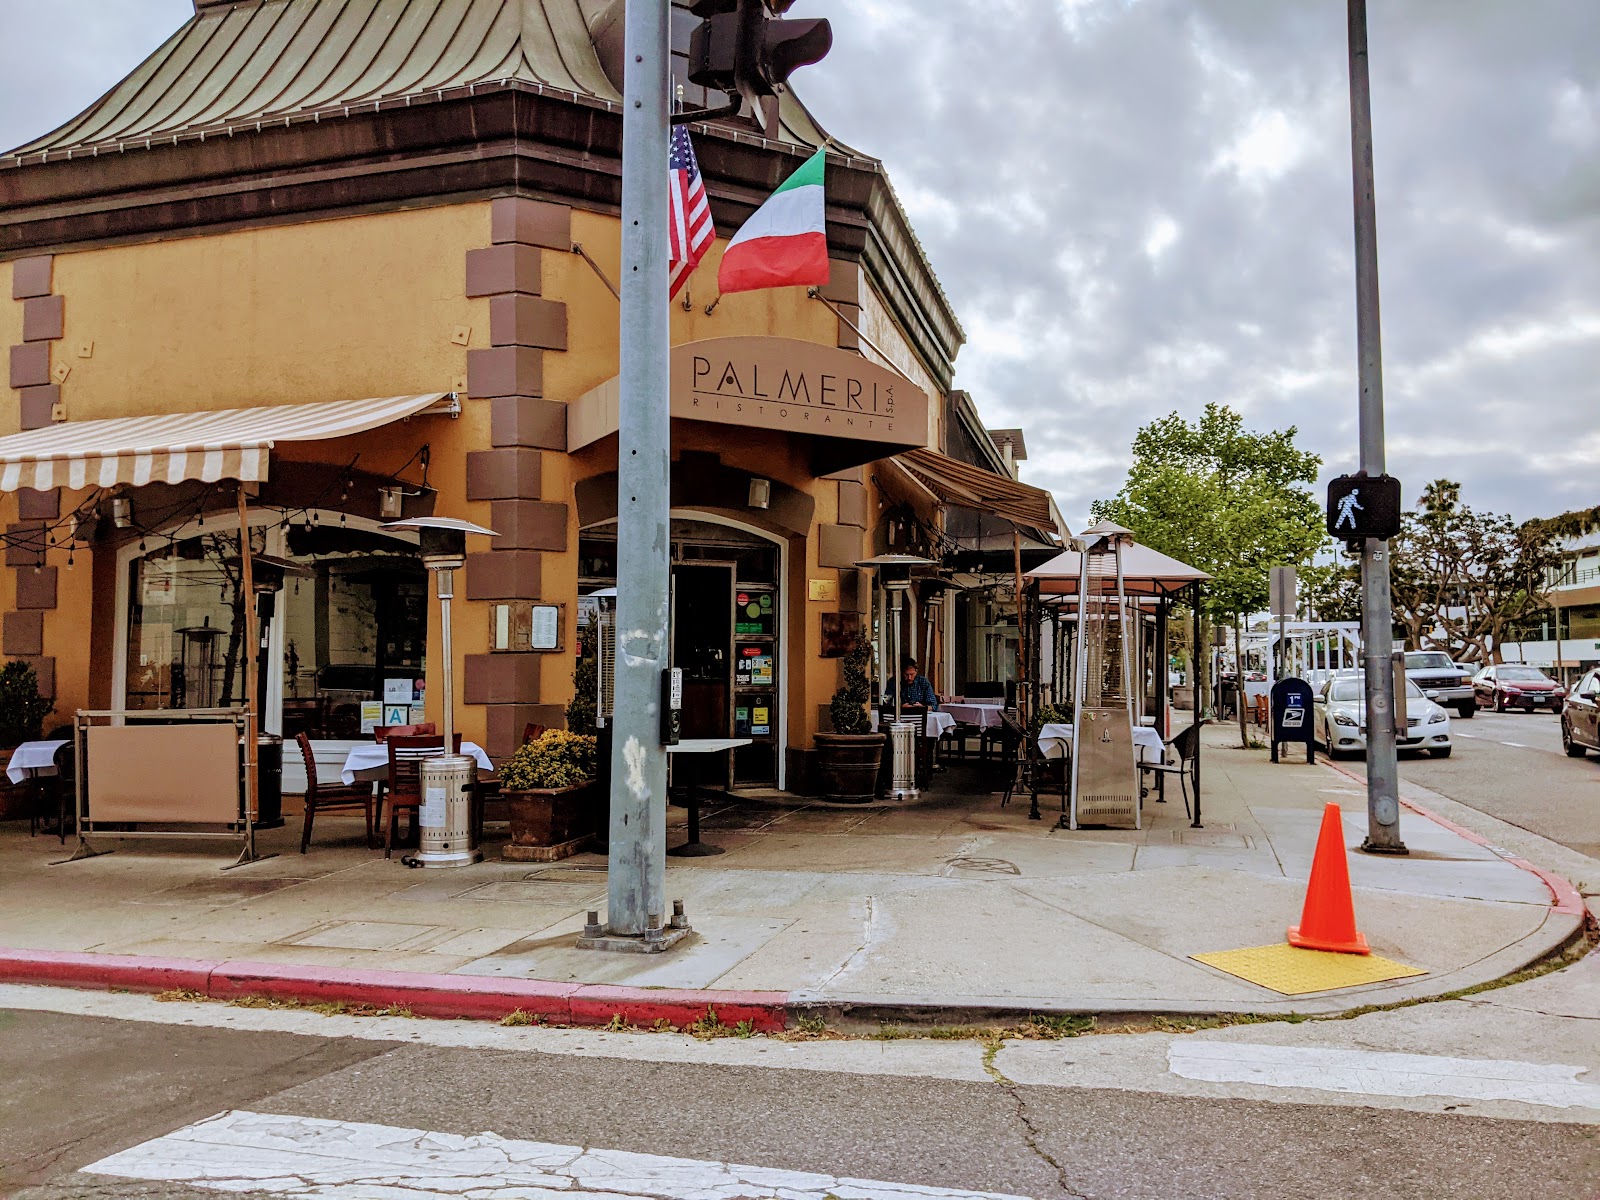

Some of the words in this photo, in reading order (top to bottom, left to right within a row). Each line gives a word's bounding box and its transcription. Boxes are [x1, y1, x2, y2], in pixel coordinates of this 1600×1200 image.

[693, 356, 877, 412] PALMERI
[693, 398, 893, 431] RISTORANTE
[389, 708, 402, 723] A
